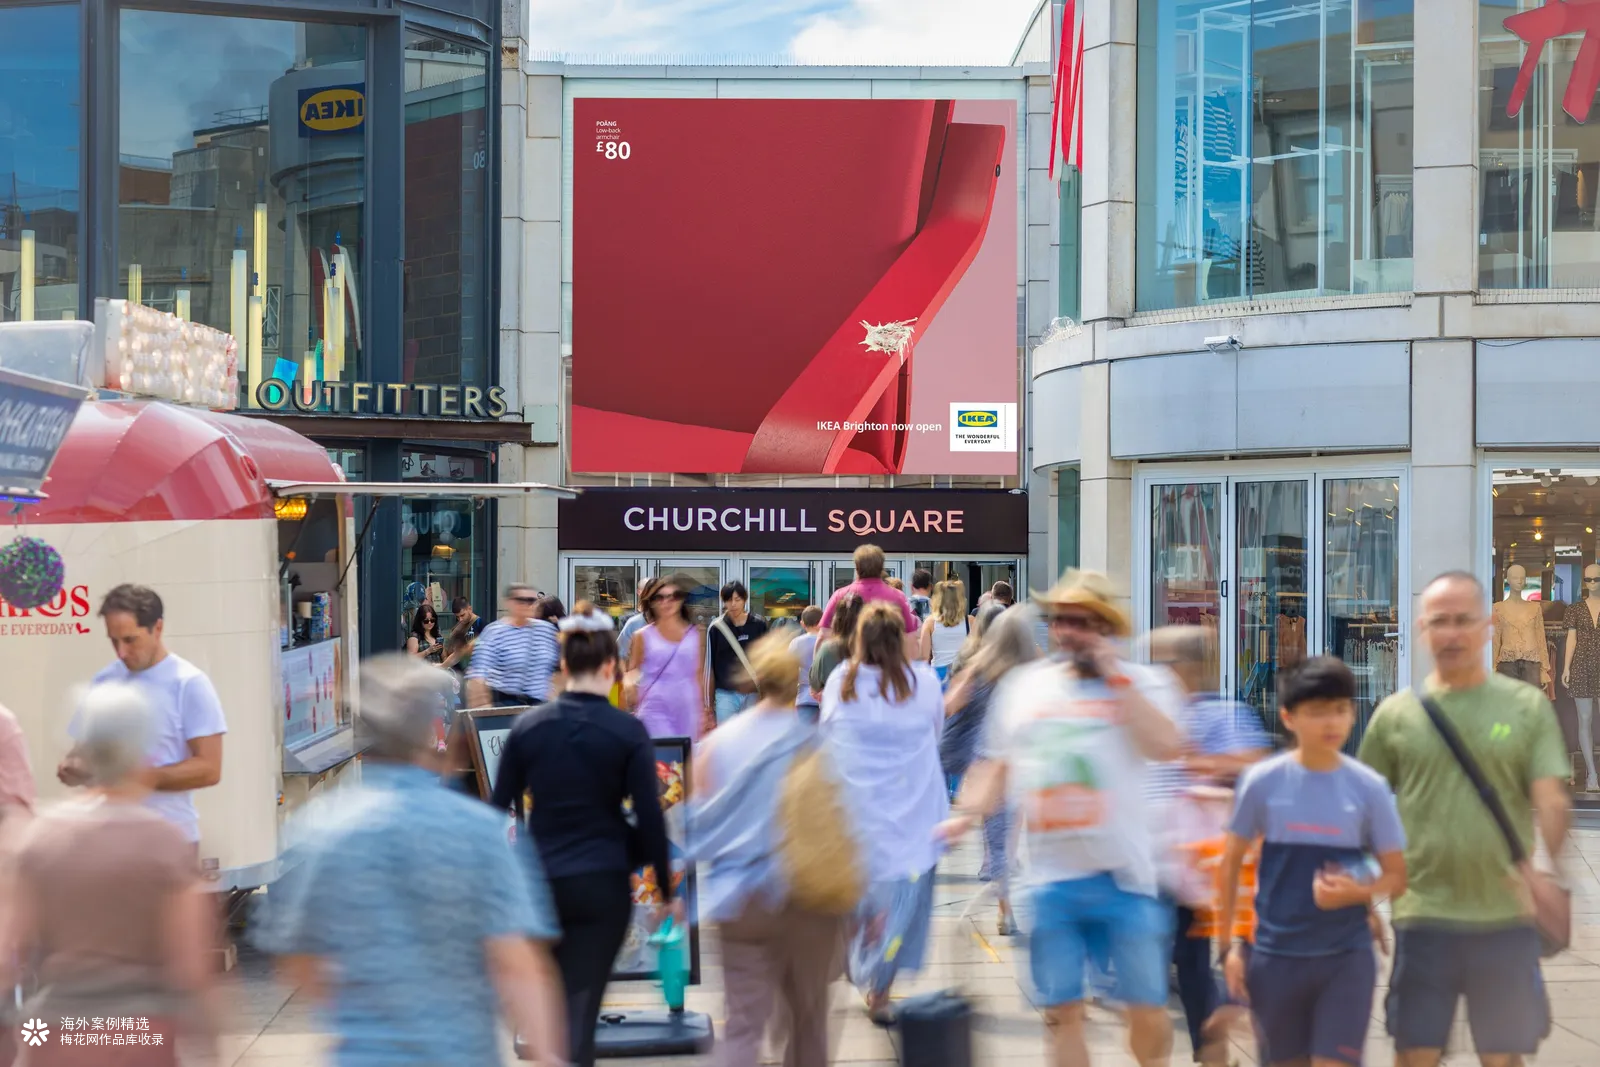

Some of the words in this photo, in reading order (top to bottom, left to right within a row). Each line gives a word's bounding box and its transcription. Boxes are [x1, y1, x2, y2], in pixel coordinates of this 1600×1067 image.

[596, 141, 631, 160] £80
[256, 378, 508, 418] OUTFITTERS
[816, 421, 841, 431] IKEA
[843, 421, 889, 433] Brighton
[891, 423, 914, 431] now
[915, 423, 942, 434] open
[623, 507, 817, 533] CHURCHILL
[828, 509, 965, 536] SQUARE
[11, 623, 74, 636] EVERYDAY
